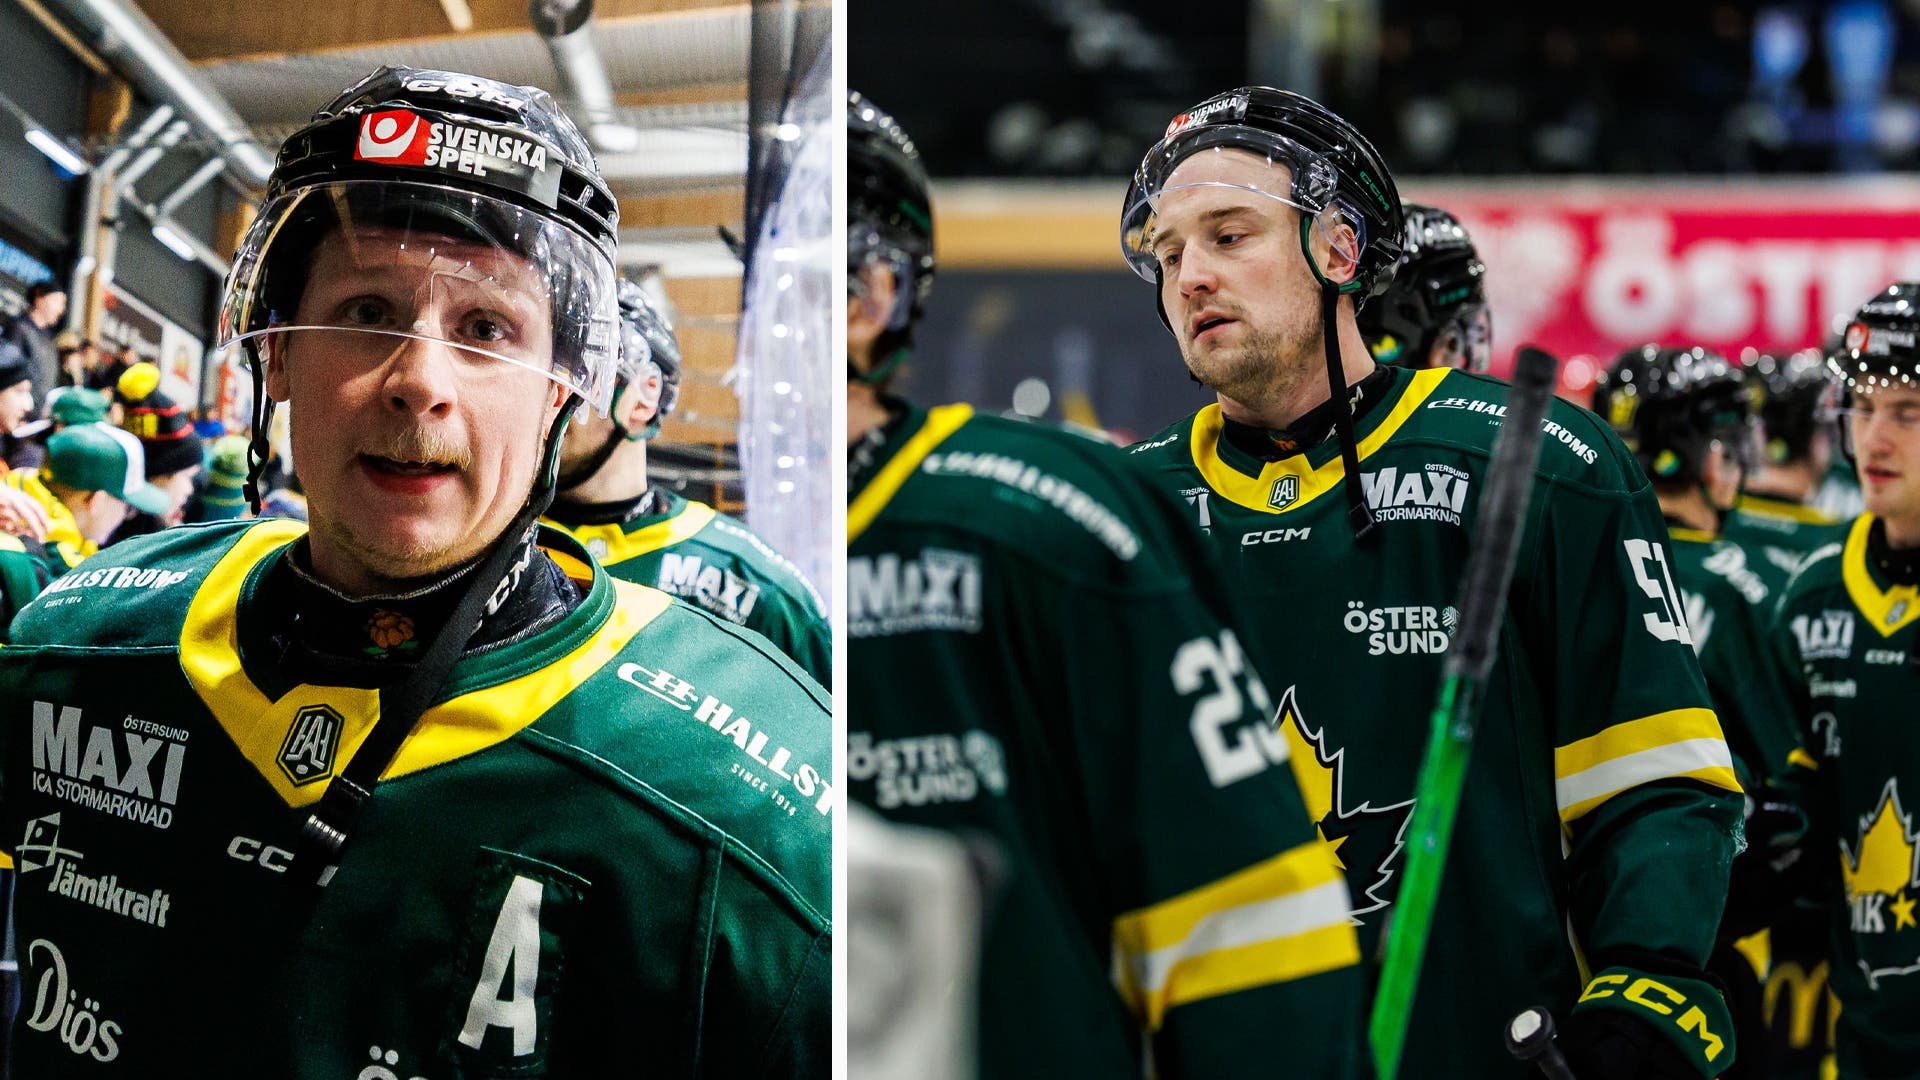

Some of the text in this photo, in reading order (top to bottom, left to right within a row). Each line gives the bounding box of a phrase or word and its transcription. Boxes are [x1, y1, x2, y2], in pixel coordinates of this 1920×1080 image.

[1188, 97, 1238, 121] SVENSKA
[423, 144, 487, 177] SPEL
[427, 122, 547, 173] SVENSKA
[1359, 170, 1390, 212] CCM
[1359, 466, 1469, 514] MAXI
[1241, 527, 1312, 546] CCM
[1375, 506, 1461, 527] STORMARKNAD
[659, 552, 761, 620] MAXI
[1623, 538, 1694, 646] 51
[1343, 600, 1439, 633] ÖSTER
[1368, 630, 1450, 656] SUND
[32, 700, 187, 806] MAXI
[122, 714, 190, 742] ÖSTERSUND
[32, 770, 173, 830] ICA STORMARKNAD
[730, 762, 797, 817] SINCE 1914
[47, 857, 171, 929] Jämtkraft
[457, 874, 545, 1058] A
[26, 938, 123, 1063] Diös
[1577, 973, 1725, 1064] CCM
